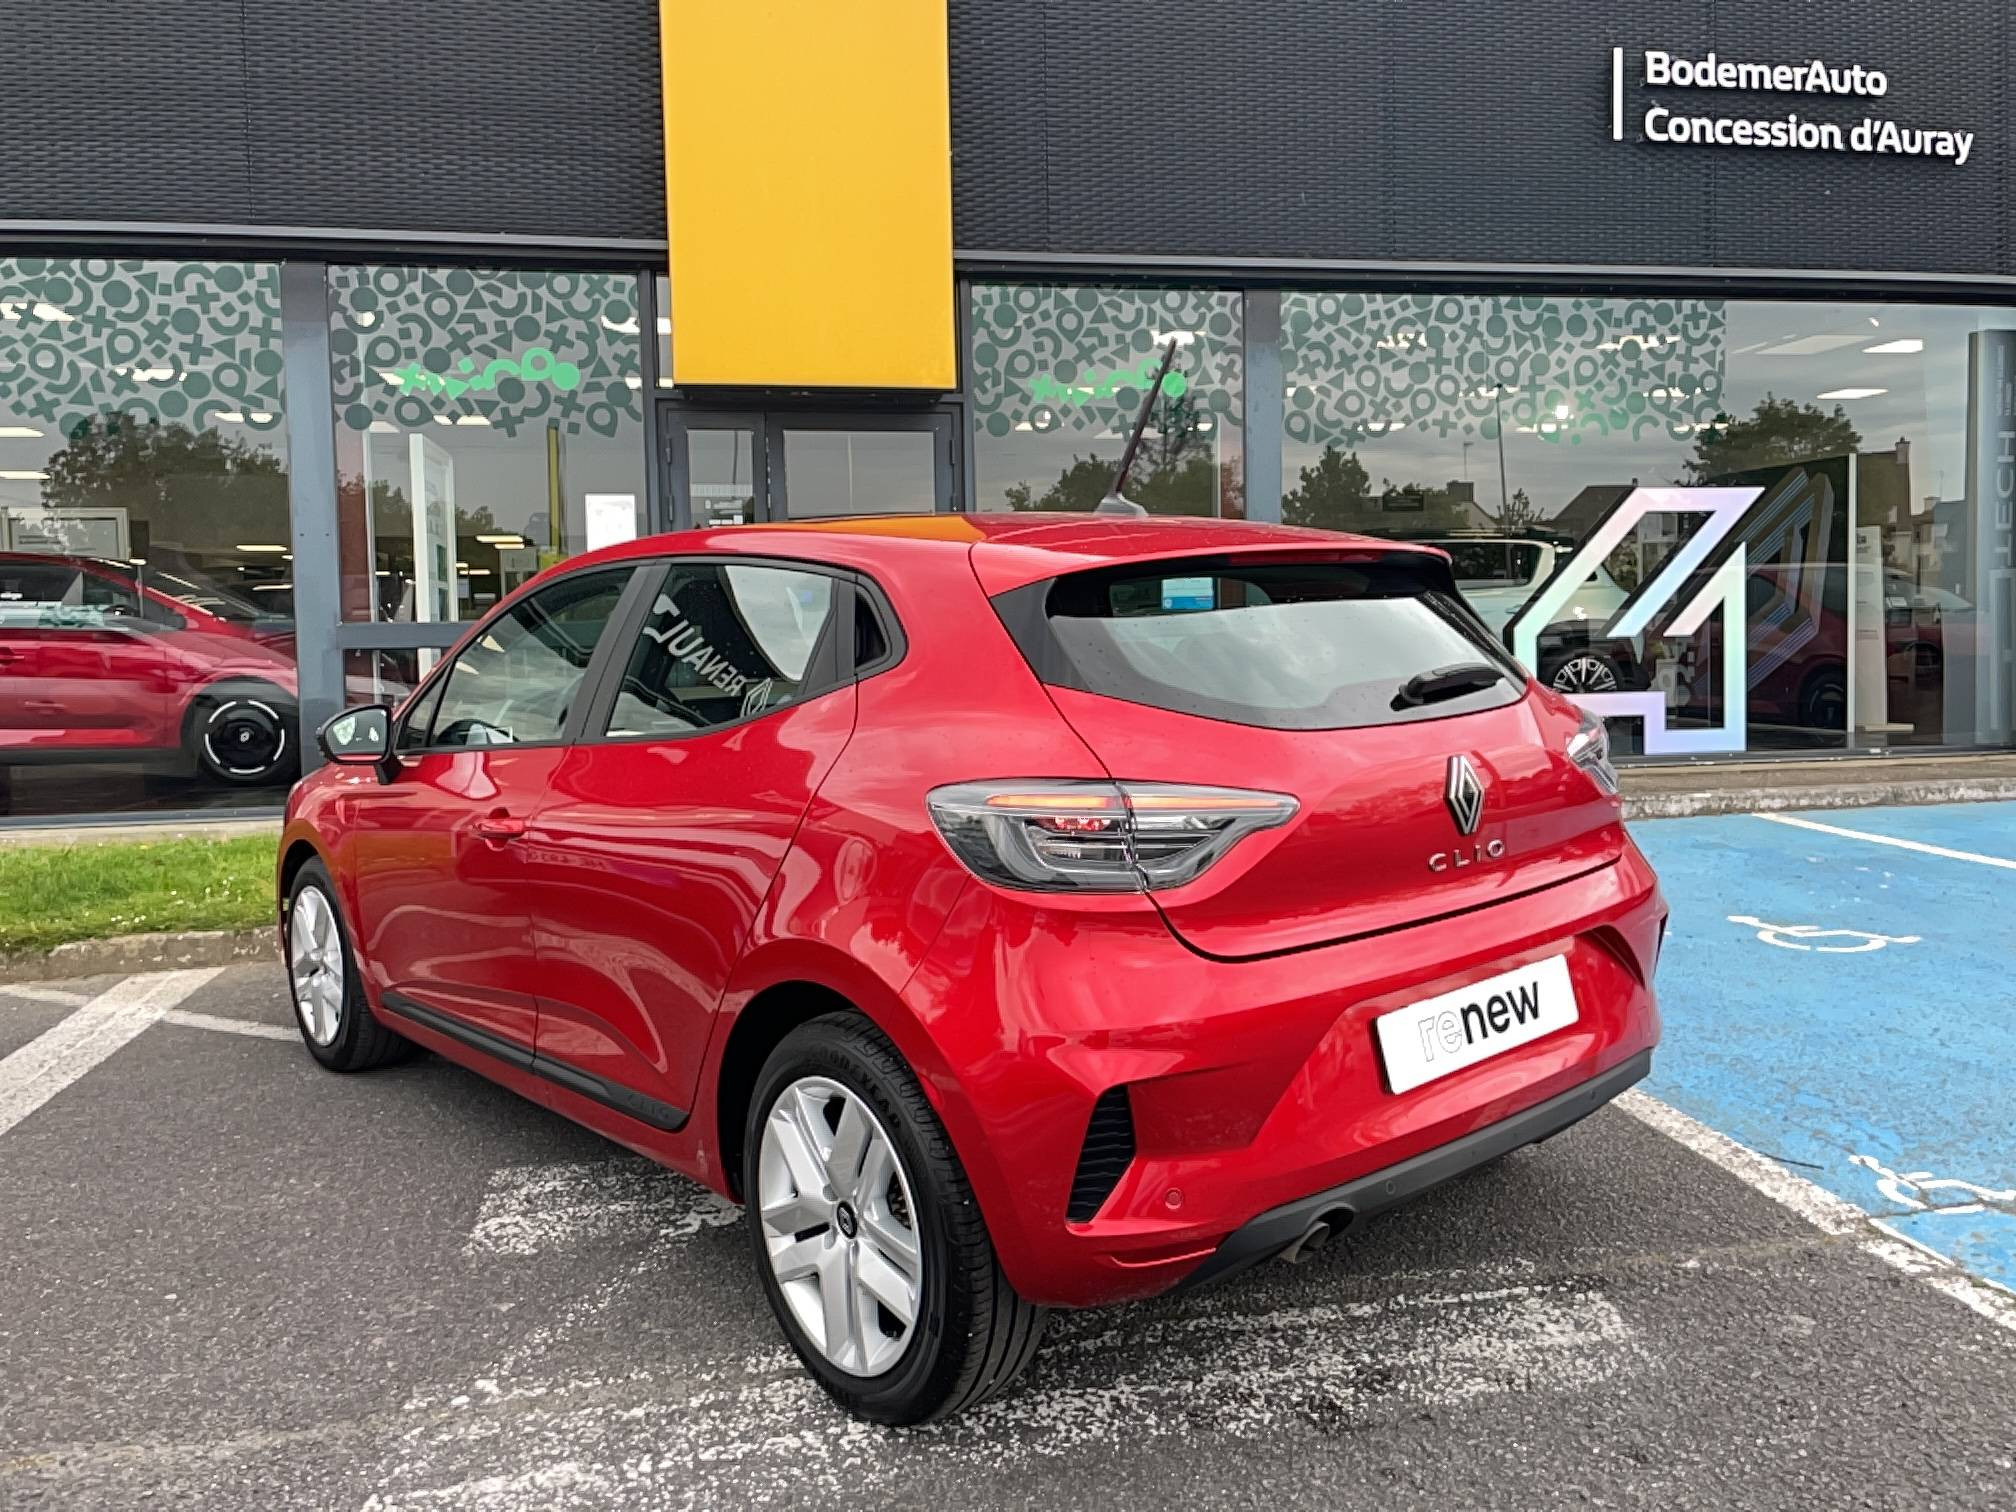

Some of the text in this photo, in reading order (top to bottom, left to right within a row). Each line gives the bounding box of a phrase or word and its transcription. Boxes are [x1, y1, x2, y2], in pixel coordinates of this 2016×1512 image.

[1645, 51, 1888, 96] BodemerAuto
[1644, 107, 1973, 165] Concession d'Auray
[1429, 839, 1504, 871] CLIO
[1417, 980, 1540, 1063] renew
